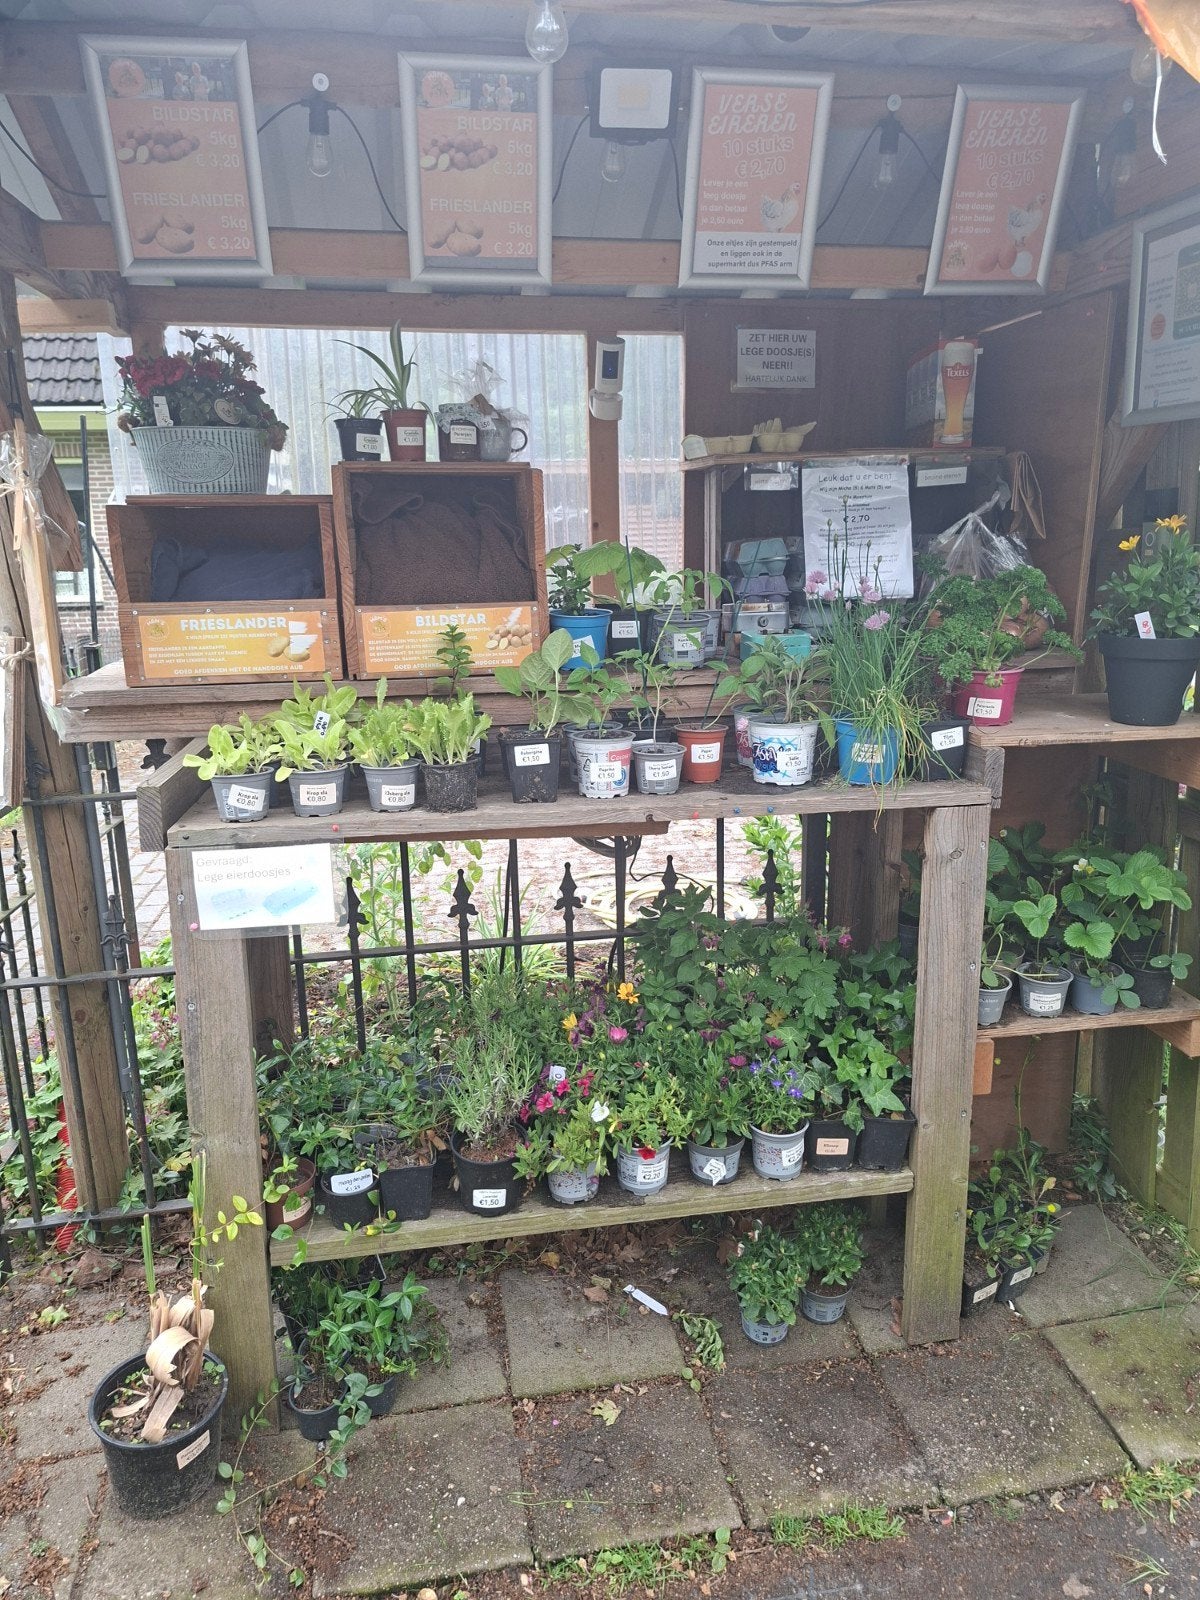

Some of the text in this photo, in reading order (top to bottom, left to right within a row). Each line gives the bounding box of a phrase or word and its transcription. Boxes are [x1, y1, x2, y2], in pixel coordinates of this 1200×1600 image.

[719, 92, 789, 114] VERSE
[152, 106, 235, 122] BILDSTAR
[976, 108, 1042, 130] VERSE
[457, 116, 533, 133] BILDSTAR
[210, 131, 238, 149] 5kg
[723, 134, 794, 158] 10 stuks
[507, 140, 532, 158] 5kg
[210, 153, 240, 169] 3,20
[977, 147, 1044, 170] 10 stuks
[504, 162, 533, 177] 3,20
[736, 156, 786, 179] € 2,70
[704, 179, 725, 188] Lever
[133, 192, 246, 208] FRIESLANDER
[430, 198, 533, 215] FRIESLANDER
[221, 215, 248, 232] 5kg
[508, 222, 533, 238] 5kg
[207, 236, 250, 252] € 3,20
[494, 242, 533, 256] € 3,20
[707, 239, 798, 248] Onze eitjes zijn gestempeld
[730, 250, 751, 259] liggen
[708, 260, 746, 269] supermarkt
[748, 260, 759, 268] dus
[761, 260, 778, 268] PFAS
[749, 334, 807, 343] ZET HIER UW
[740, 347, 815, 357] LEGE DOOSJE(S)
[762, 360, 793, 370] NEER!!
[818, 474, 838, 483] Leuk
[840, 474, 853, 482] dat
[851, 514, 870, 523] 2,70
[180, 616, 287, 632] FRIESLANDER
[416, 612, 486, 628] BILDSTAR
[236, 798, 256, 807] €0,80
[237, 792, 252, 800] Krop
[307, 795, 327, 804] €0,80
[196, 855, 252, 868] Gevraagd:
[197, 868, 291, 884] Lege eierdoosjes
[480, 1198, 500, 1207] €1,50
